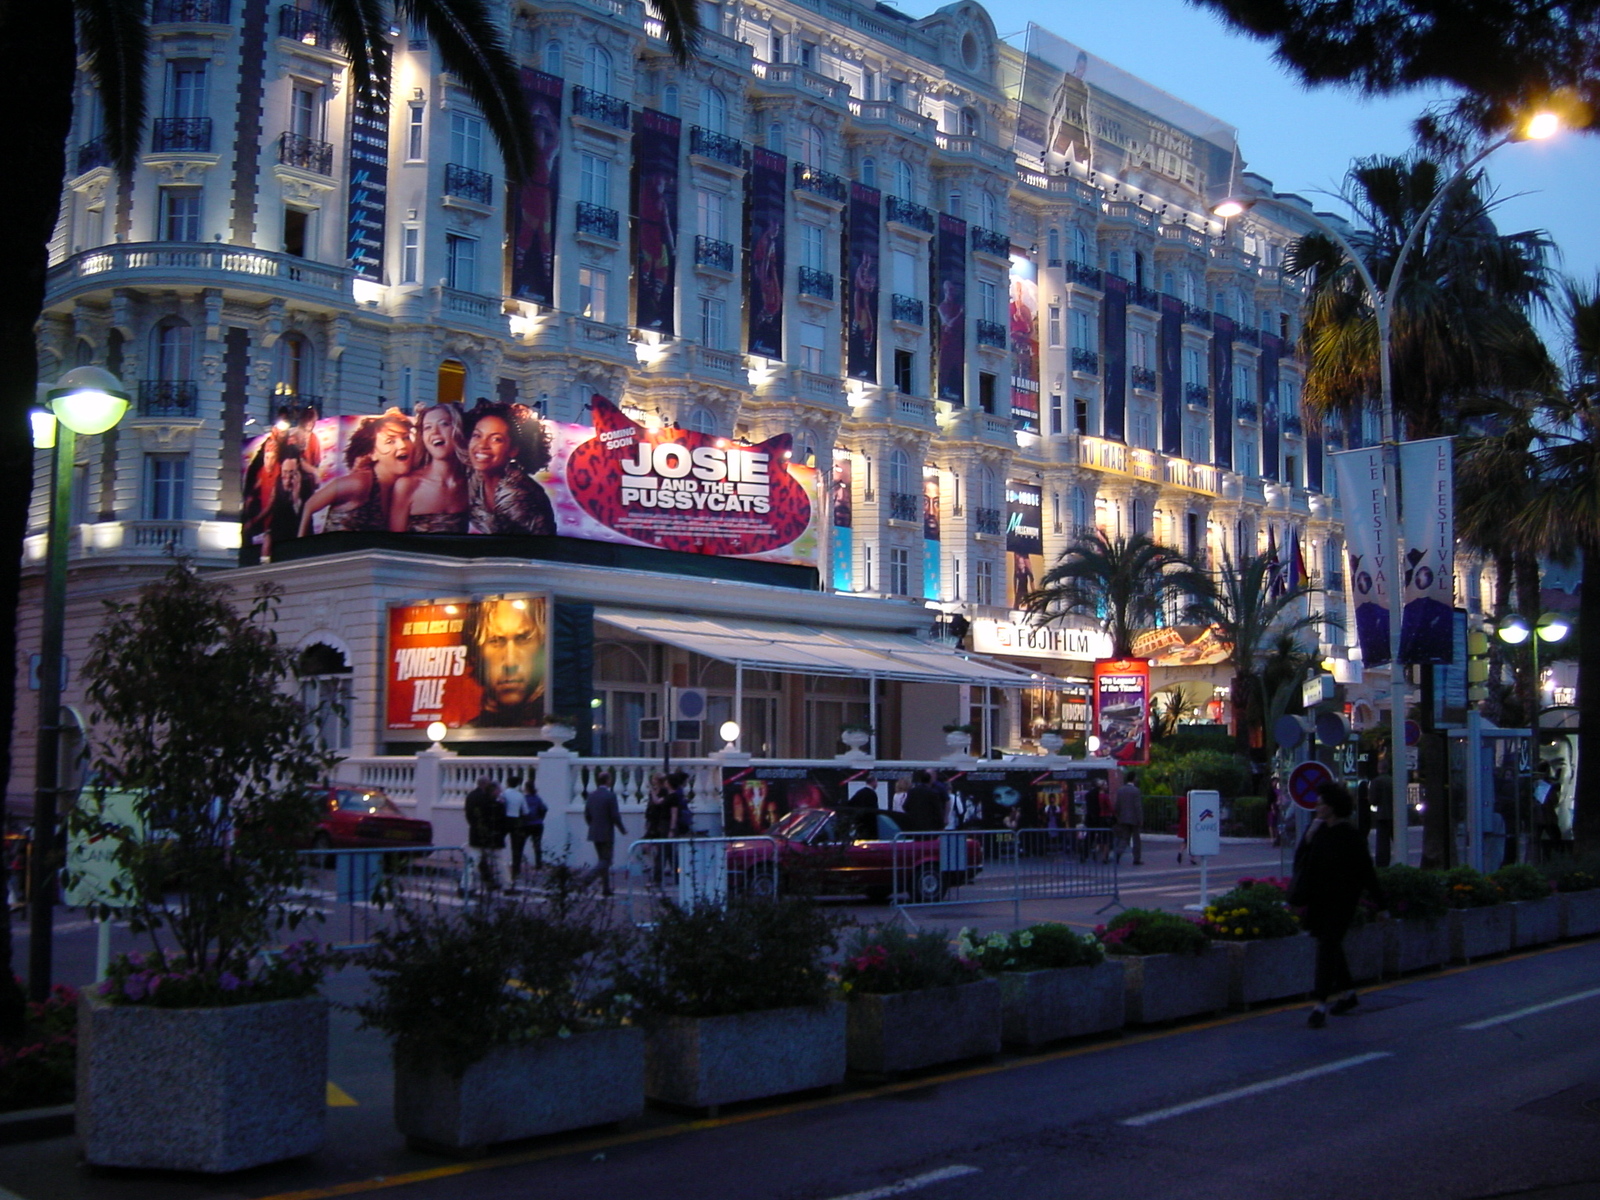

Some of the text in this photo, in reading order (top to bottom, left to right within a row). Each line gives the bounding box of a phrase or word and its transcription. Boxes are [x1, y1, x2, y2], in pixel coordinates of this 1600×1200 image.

[1127, 139, 1207, 198] RAIDER
[599, 427, 636, 442] COMING
[606, 437, 633, 450] SOON
[620, 442, 770, 484] JOSIE
[1370, 455, 1378, 481] LE
[1438, 445, 1446, 471] LE
[660, 478, 735, 495] AND THE
[621, 487, 771, 514] PUSSYCATS
[1372, 488, 1386, 595] FESTIVAL
[1437, 480, 1448, 590] FESTIVAL
[1018, 628, 1089, 653] FUJIFILM
[397, 645, 468, 681] KNIGHT'S
[1100, 677, 1112, 685] The
[412, 678, 447, 712] TALE
